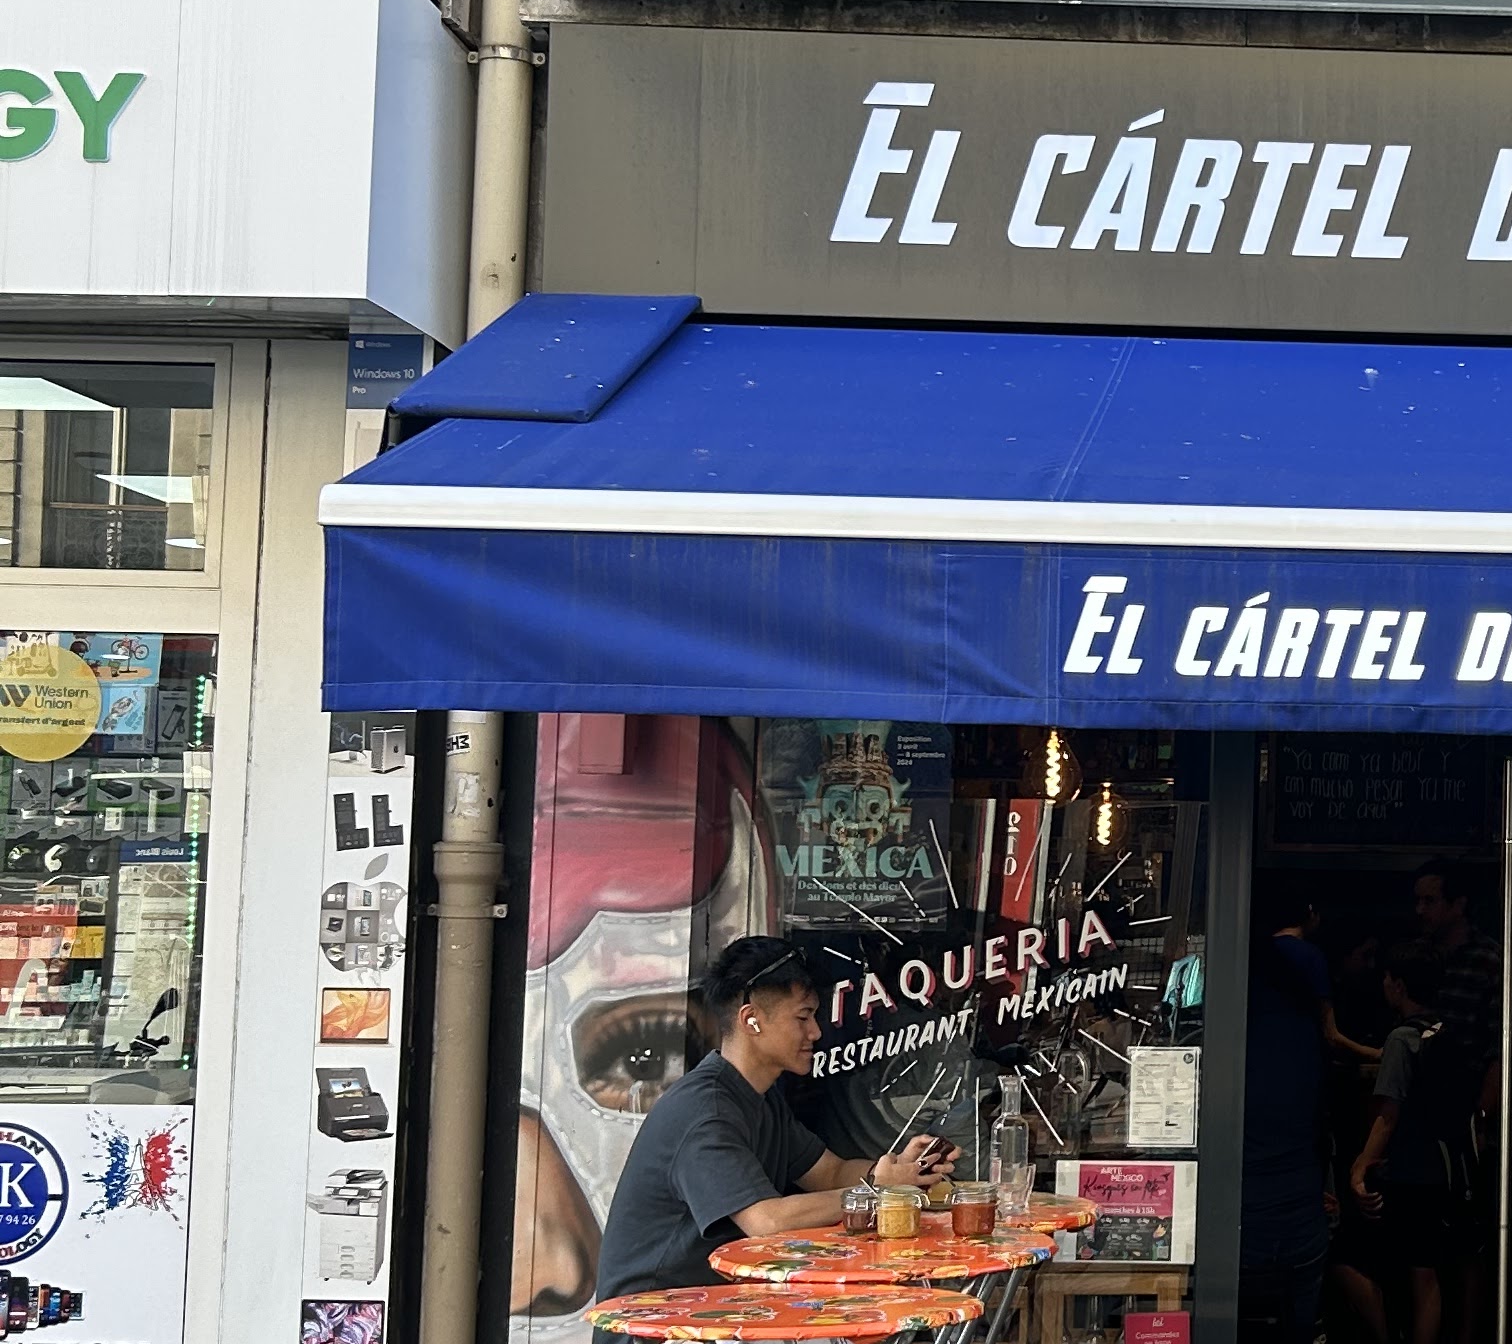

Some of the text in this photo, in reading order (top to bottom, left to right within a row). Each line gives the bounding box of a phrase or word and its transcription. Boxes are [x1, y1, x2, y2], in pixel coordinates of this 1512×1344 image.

[829, 82, 961, 245] EL
[1007, 108, 1412, 260] CÁRTEL
[352, 386, 366, 394] Pro
[353, 368, 415, 379] Windows 10
[1062, 576, 1146, 676] EL
[1174, 592, 1428, 681] CÁRTEL
[34, 684, 89, 698] Western
[34, 697, 73, 709] Union
[775, 844, 934, 879] MEXICA
[830, 909, 1117, 1028] TAQUERIA
[812, 963, 1128, 1078] RESTAURANT MEXICAIN
[1, 1162, 36, 1207] K
[22, 1215, 35, 1225] 26
